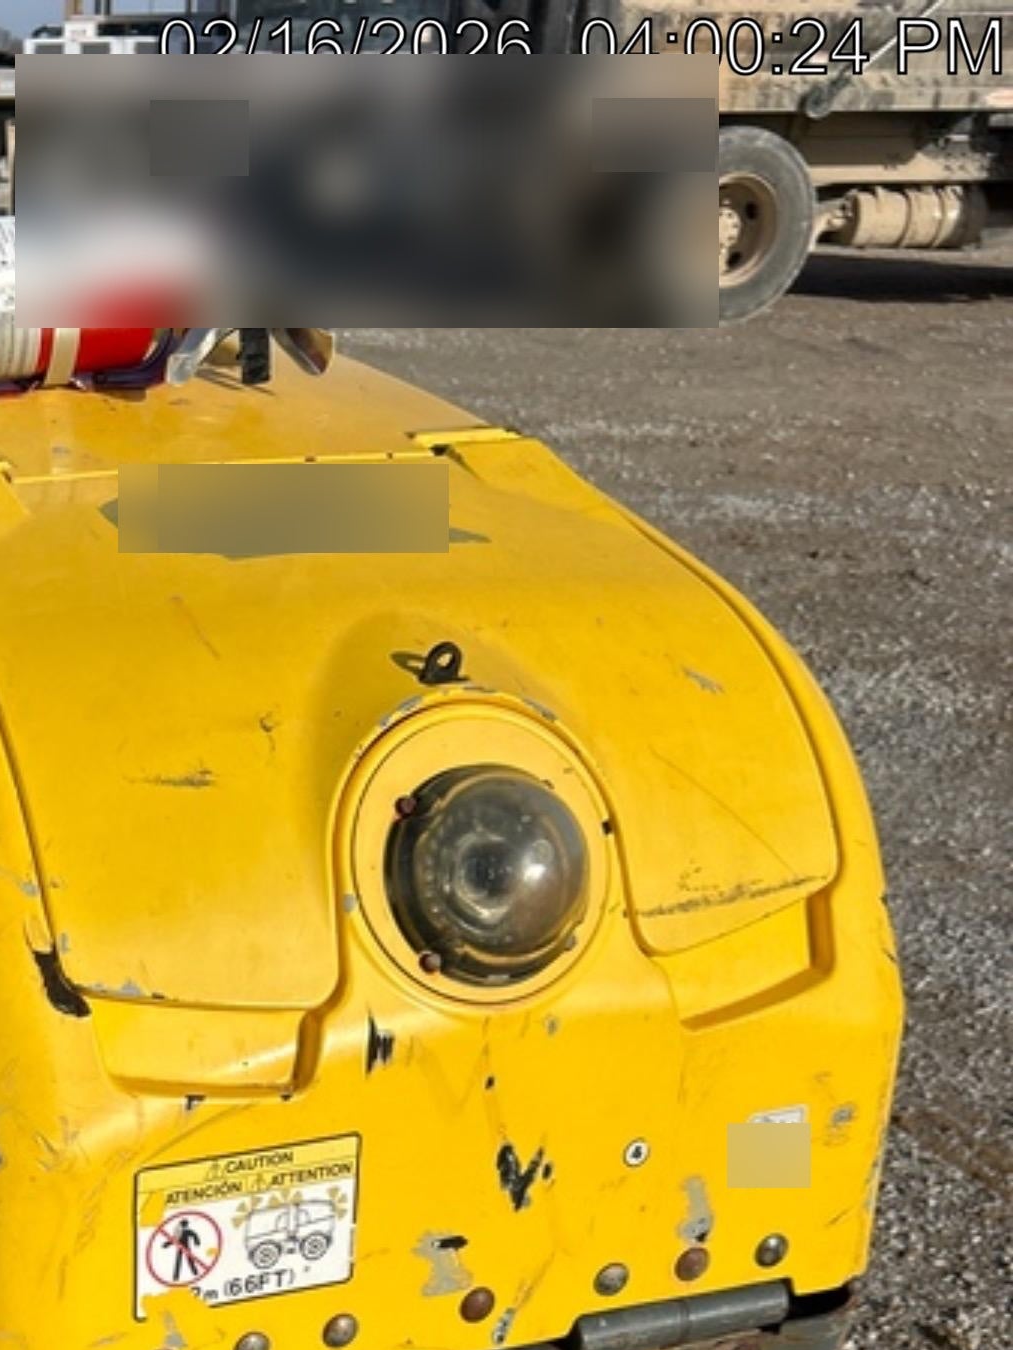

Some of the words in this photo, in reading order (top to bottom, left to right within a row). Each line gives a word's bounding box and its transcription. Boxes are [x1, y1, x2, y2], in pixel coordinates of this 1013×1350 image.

[225, 1152, 293, 1173] CAUTION
[271, 1164, 351, 1186] ATTENTION
[224, 1268, 295, 1297] (66FT)
